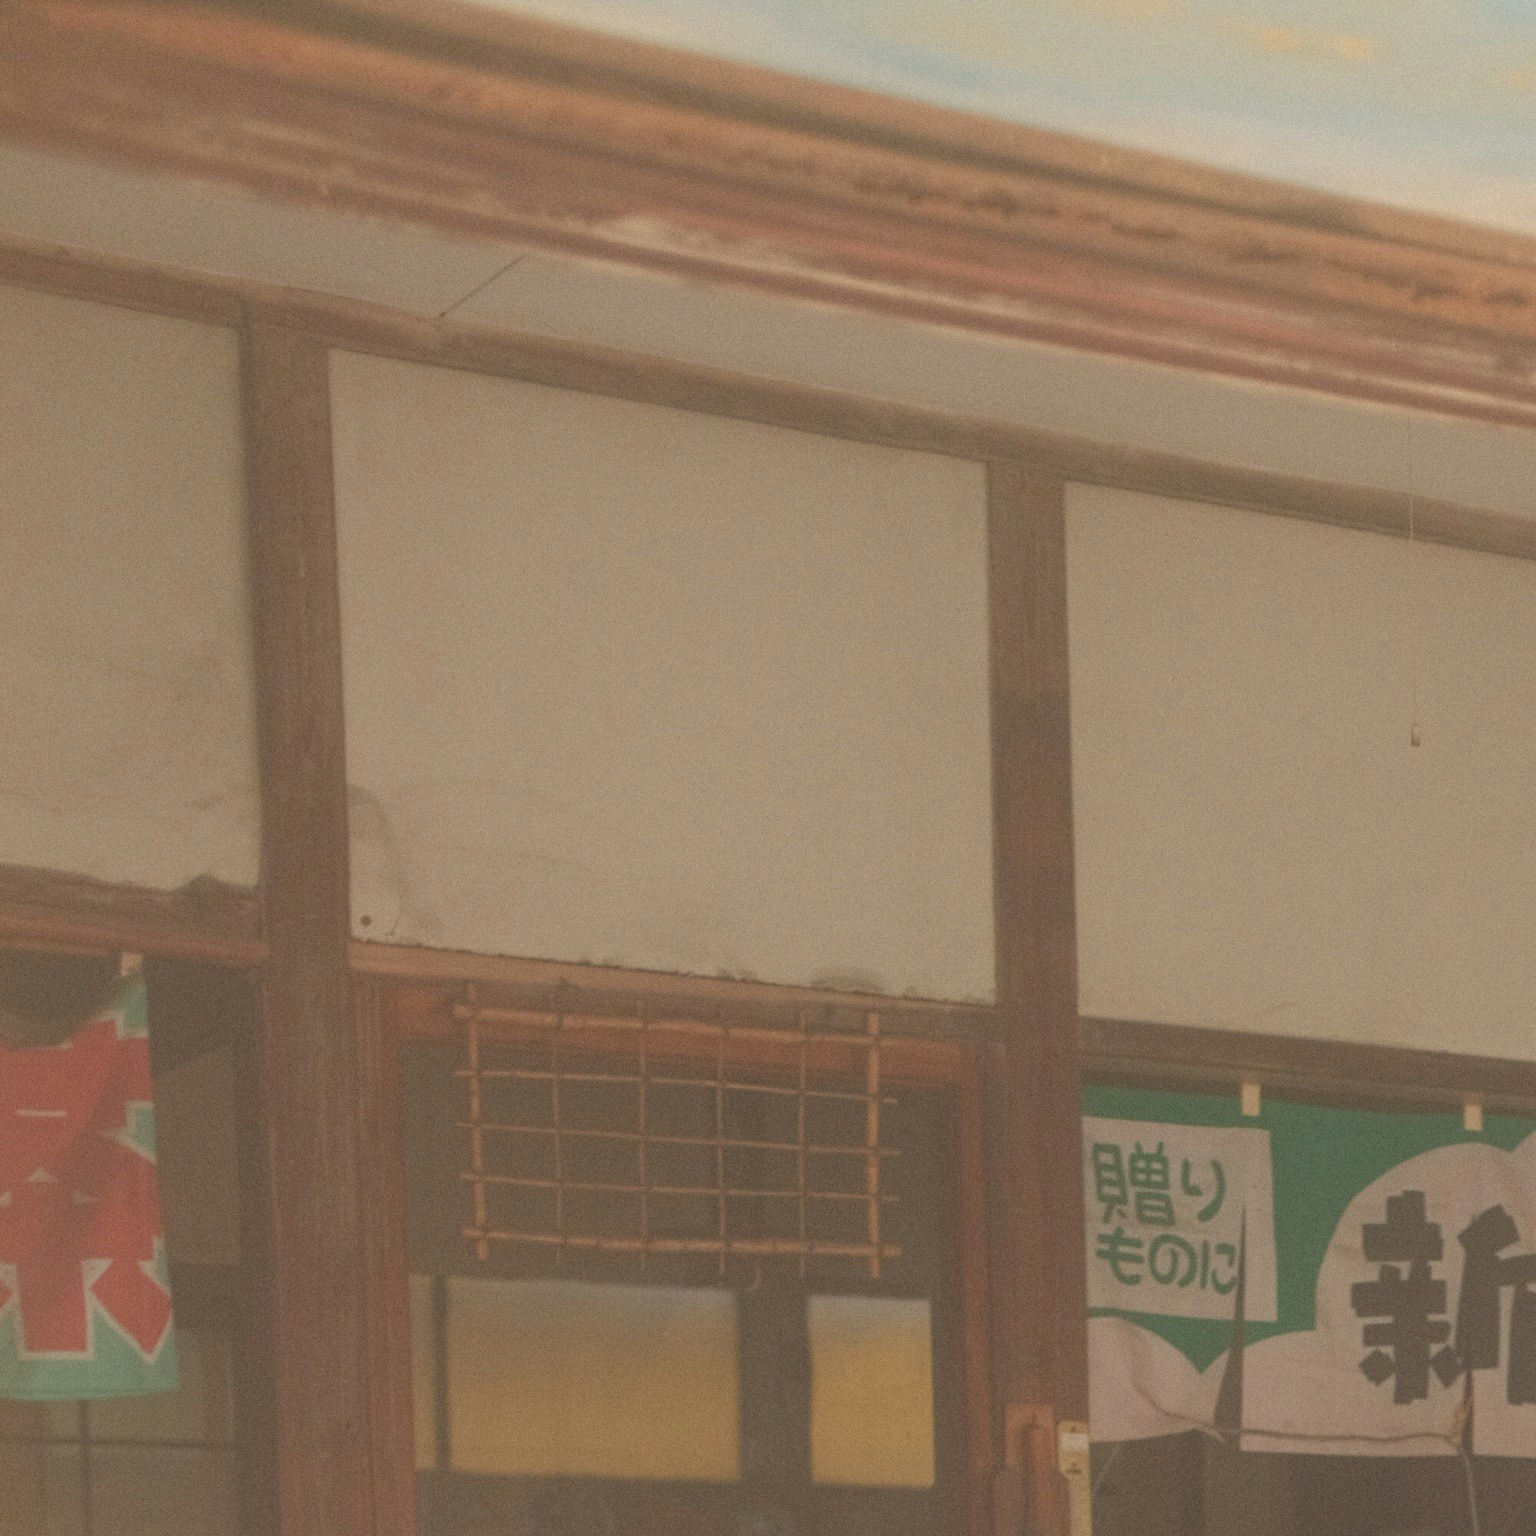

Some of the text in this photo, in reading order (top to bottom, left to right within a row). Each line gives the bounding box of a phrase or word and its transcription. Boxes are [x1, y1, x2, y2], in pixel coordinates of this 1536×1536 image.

[1092, 1141, 1227, 1227] 贈り
[1094, 1228, 1239, 1293] ものに
